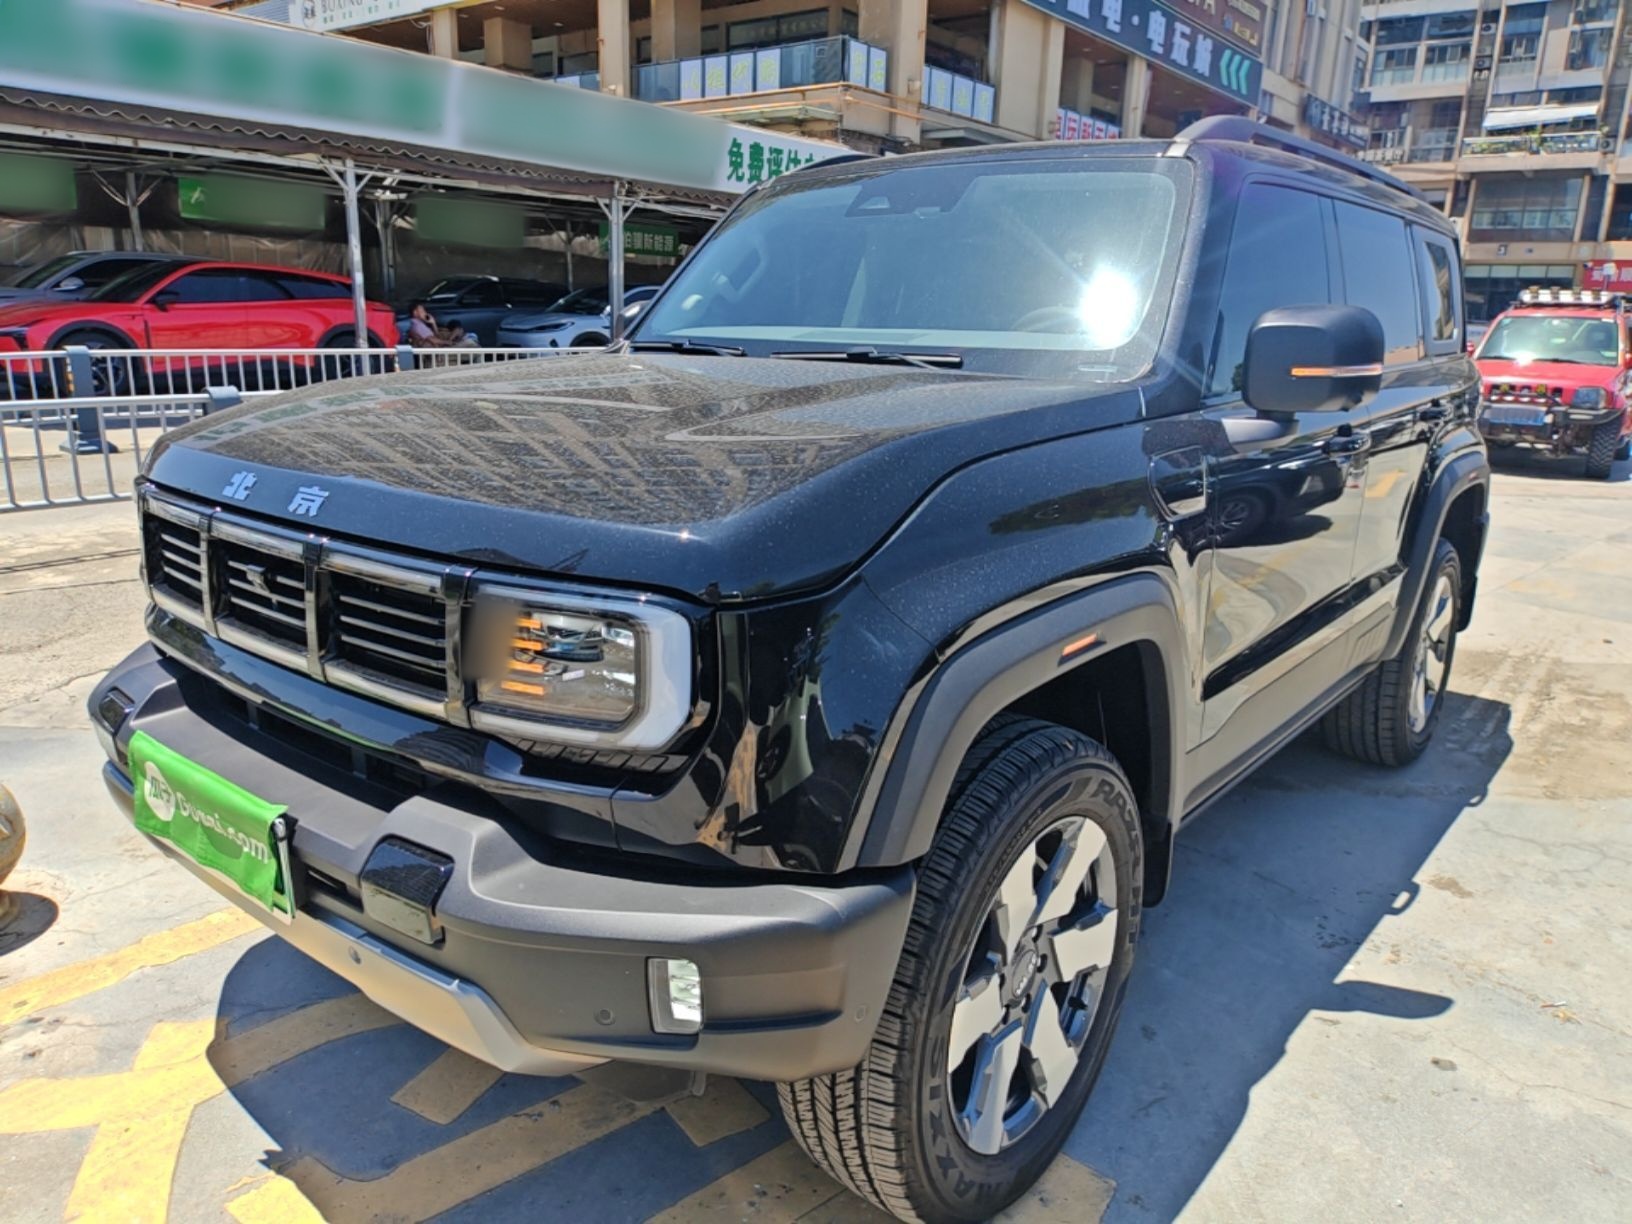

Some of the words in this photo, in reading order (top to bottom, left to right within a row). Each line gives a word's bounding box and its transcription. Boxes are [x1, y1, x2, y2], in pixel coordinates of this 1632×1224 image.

[727, 137, 815, 184] 免费评估
[222, 471, 329, 517] 北京
